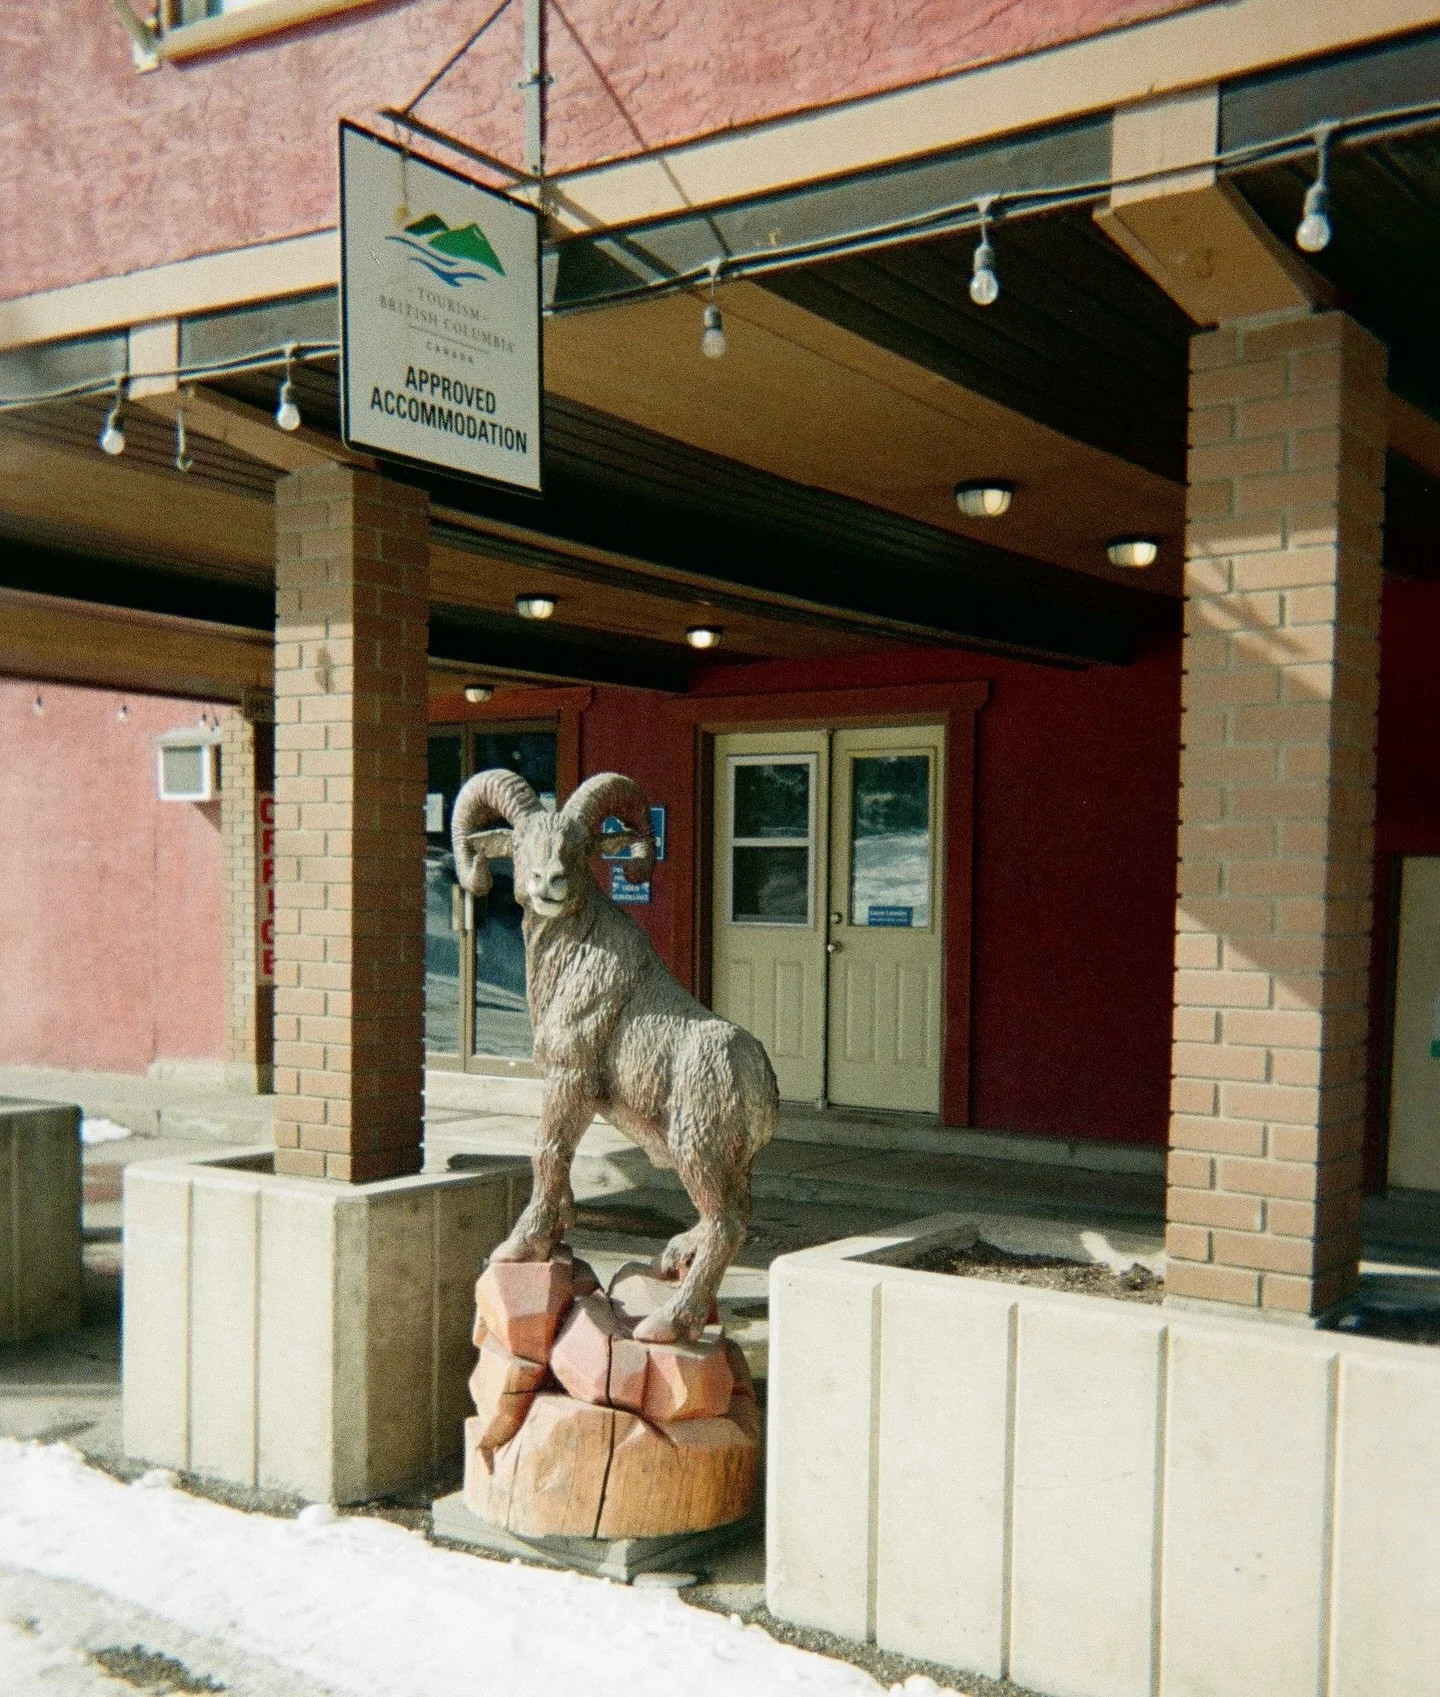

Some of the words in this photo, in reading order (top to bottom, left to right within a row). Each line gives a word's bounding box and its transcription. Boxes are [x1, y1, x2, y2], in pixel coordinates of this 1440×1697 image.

[379, 295, 437, 326] BRITISH
[443, 318, 516, 352] COLUMBIA
[418, 286, 480, 320] TOURISM
[405, 365, 497, 415] APPROVED
[370, 386, 528, 454] ACCOMMODATION
